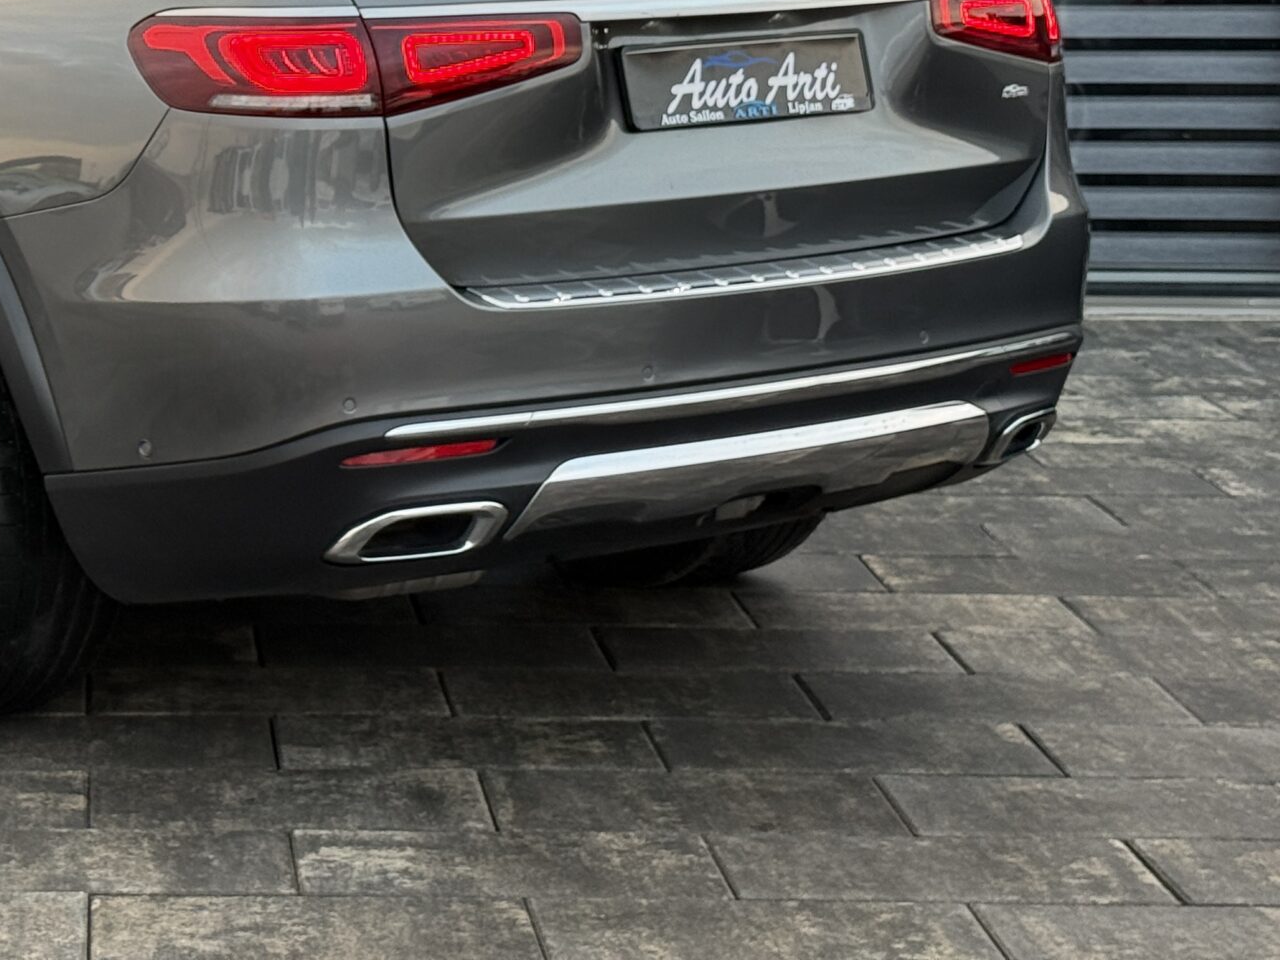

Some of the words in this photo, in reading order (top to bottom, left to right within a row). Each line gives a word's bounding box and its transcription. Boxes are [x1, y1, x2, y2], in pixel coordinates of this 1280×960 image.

[667, 58, 759, 114] Auto
[766, 52, 841, 104] Arti
[735, 103, 778, 118] ARTI
[788, 101, 823, 114] Lipjan
[661, 113, 689, 126] Auto
